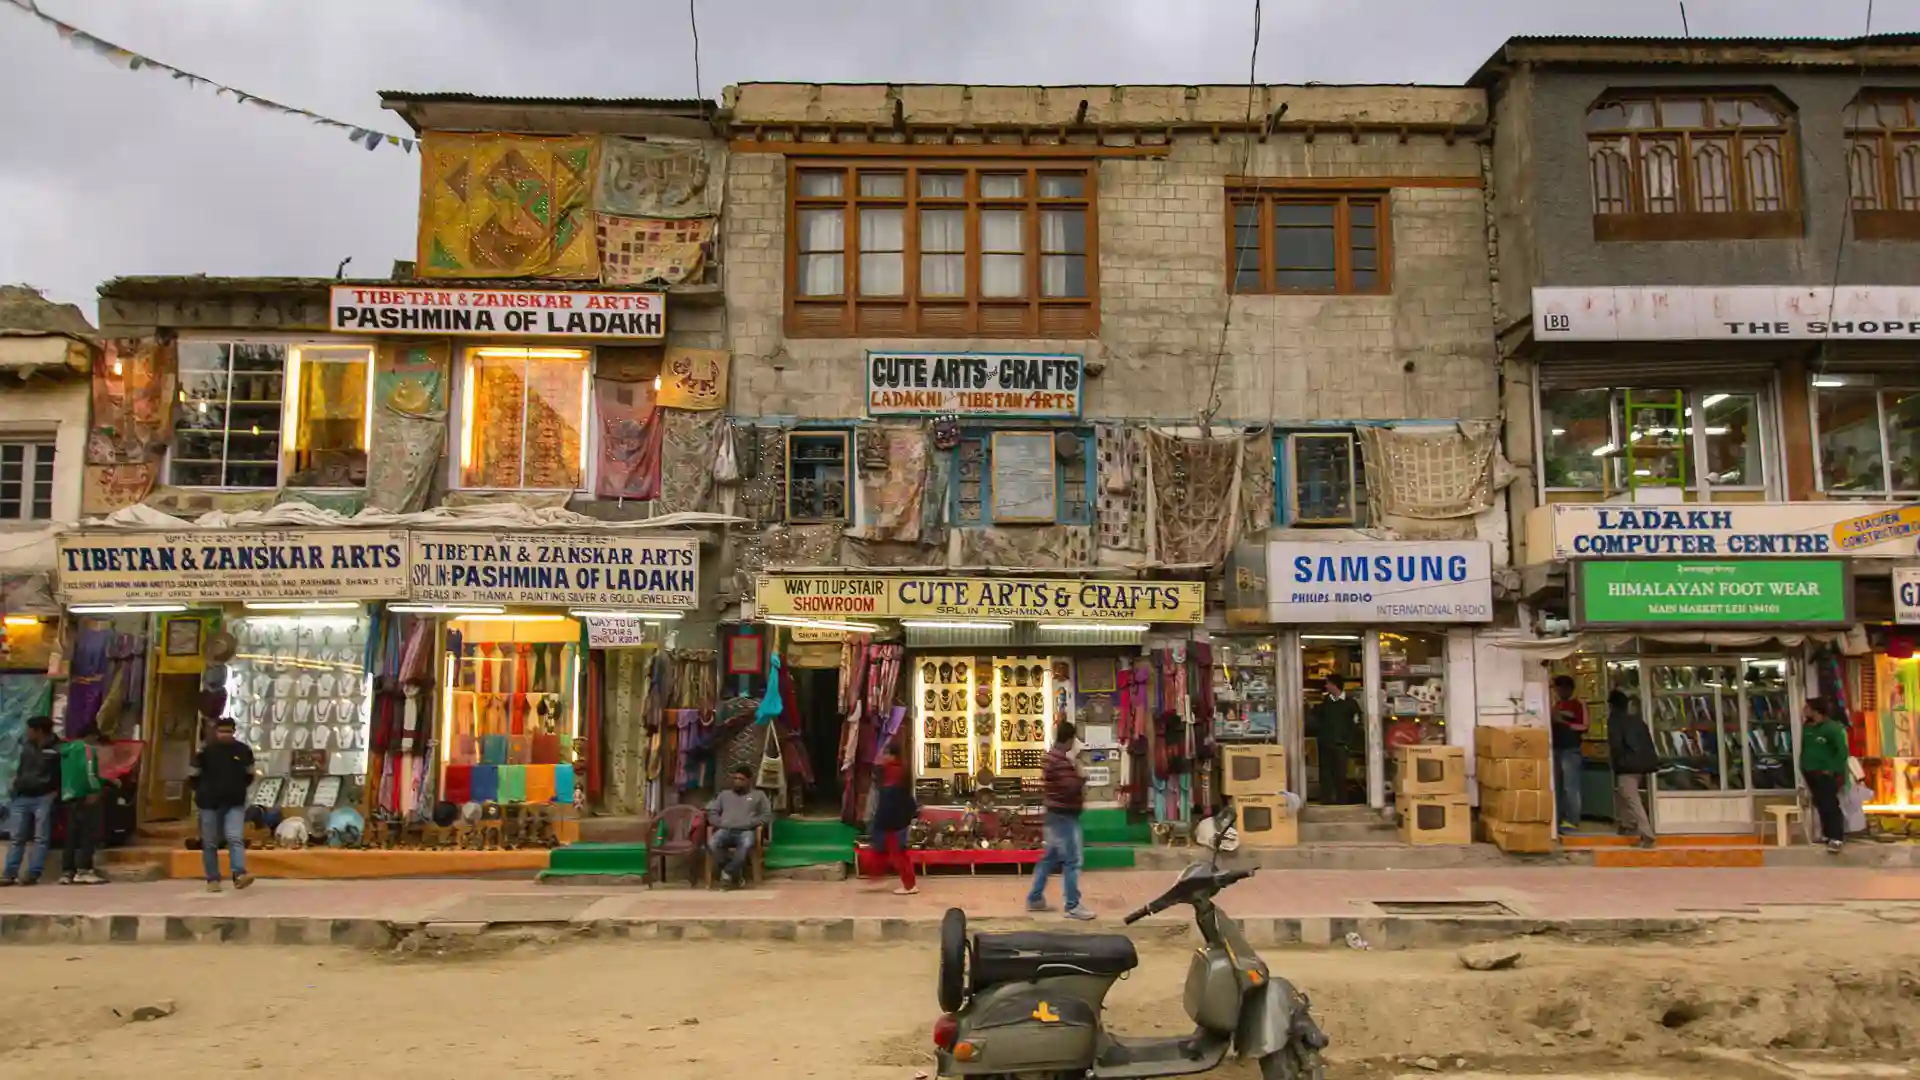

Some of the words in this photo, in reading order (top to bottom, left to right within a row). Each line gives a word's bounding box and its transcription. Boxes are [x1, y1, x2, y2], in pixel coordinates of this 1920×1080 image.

[352, 290, 453, 307] TIBETAN
[457, 293, 468, 306] &
[473, 293, 573, 310] ZANSKAR
[585, 296, 650, 311] ARTS
[337, 306, 496, 331] PASHMINA
[504, 311, 538, 332] OF
[547, 311, 661, 335] LADAKH
[1543, 313, 1570, 331] LBD
[1723, 322, 1790, 334] THE
[872, 358, 927, 388] CUTE
[931, 358, 987, 390] ARTS
[999, 359, 1079, 391] CRAFTS
[956, 392, 1022, 409] TIBETAN
[1025, 390, 1076, 409] ARTS
[1597, 510, 1733, 530] LADAKH
[1573, 533, 1718, 554] COMPUTER
[1727, 533, 1829, 554] CENTRE
[62, 547, 177, 571] TIBETAN
[181, 547, 199, 570] &
[201, 546, 325, 569] ZANSKAR
[330, 545, 401, 568] ARTS
[421, 543, 511, 562] TIBETAN
[518, 546, 532, 562] &
[538, 547, 633, 564] ZANSKAR
[641, 548, 693, 565] ARTS
[1294, 556, 1467, 583] SAMSUNG
[452, 566, 569, 588] PASHMINA
[576, 568, 599, 589] OF
[606, 570, 694, 592] LADAKH
[784, 580, 813, 595] WAY
[815, 581, 830, 596] TO
[832, 581, 848, 596] UP
[849, 581, 884, 596] STAIR
[473, 591, 513, 600] THANKA
[520, 591, 565, 601] PAINTING
[567, 592, 597, 602] SILVER
[600, 592, 607, 602] &
[898, 582, 970, 606] CUTE
[976, 584, 1048, 606] ARTS
[1053, 587, 1071, 606] &
[1078, 585, 1181, 610] CRAFTS
[1608, 582, 1714, 596] HIMALAYAN
[1719, 582, 1764, 596] FOOT
[1769, 582, 1820, 597] WEAR
[794, 597, 876, 612] SHOWROOM
[1057, 608, 1075, 616] OF
[1081, 608, 1135, 617] LADAKH
[1377, 604, 1452, 614] INTERNATIONAL
[1455, 605, 1486, 615] RADIO
[1648, 604, 1678, 613] MAIN
[589, 617, 612, 627] WAY
[602, 627, 632, 635] STAIRS
[591, 635, 615, 643] SHOW
